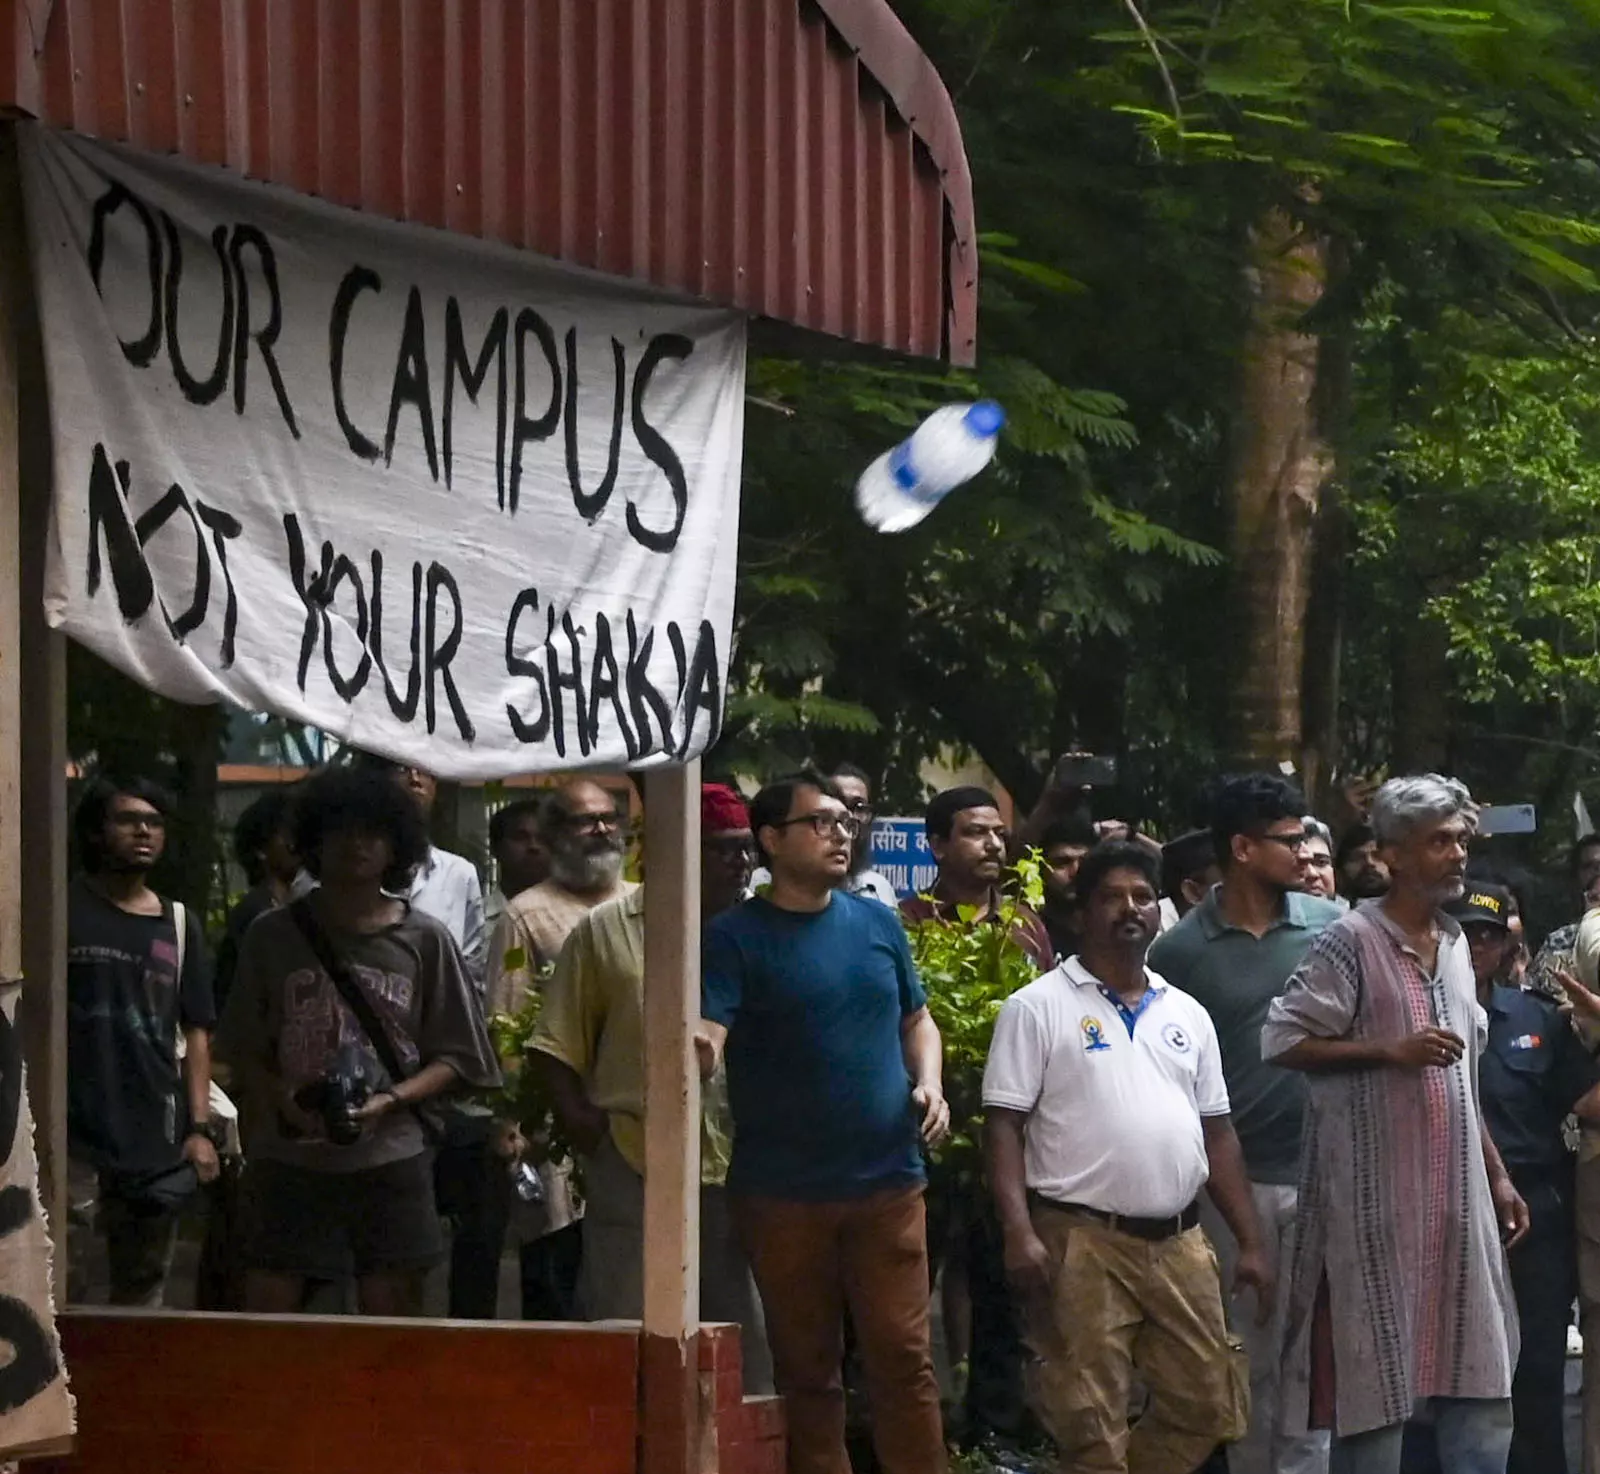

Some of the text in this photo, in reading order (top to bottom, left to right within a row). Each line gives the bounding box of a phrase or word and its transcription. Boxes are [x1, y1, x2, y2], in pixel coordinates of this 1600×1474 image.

[88, 180, 695, 553] OUR CAMPUS
[86, 442, 243, 669] NOT
[284, 512, 476, 743] YOUR
